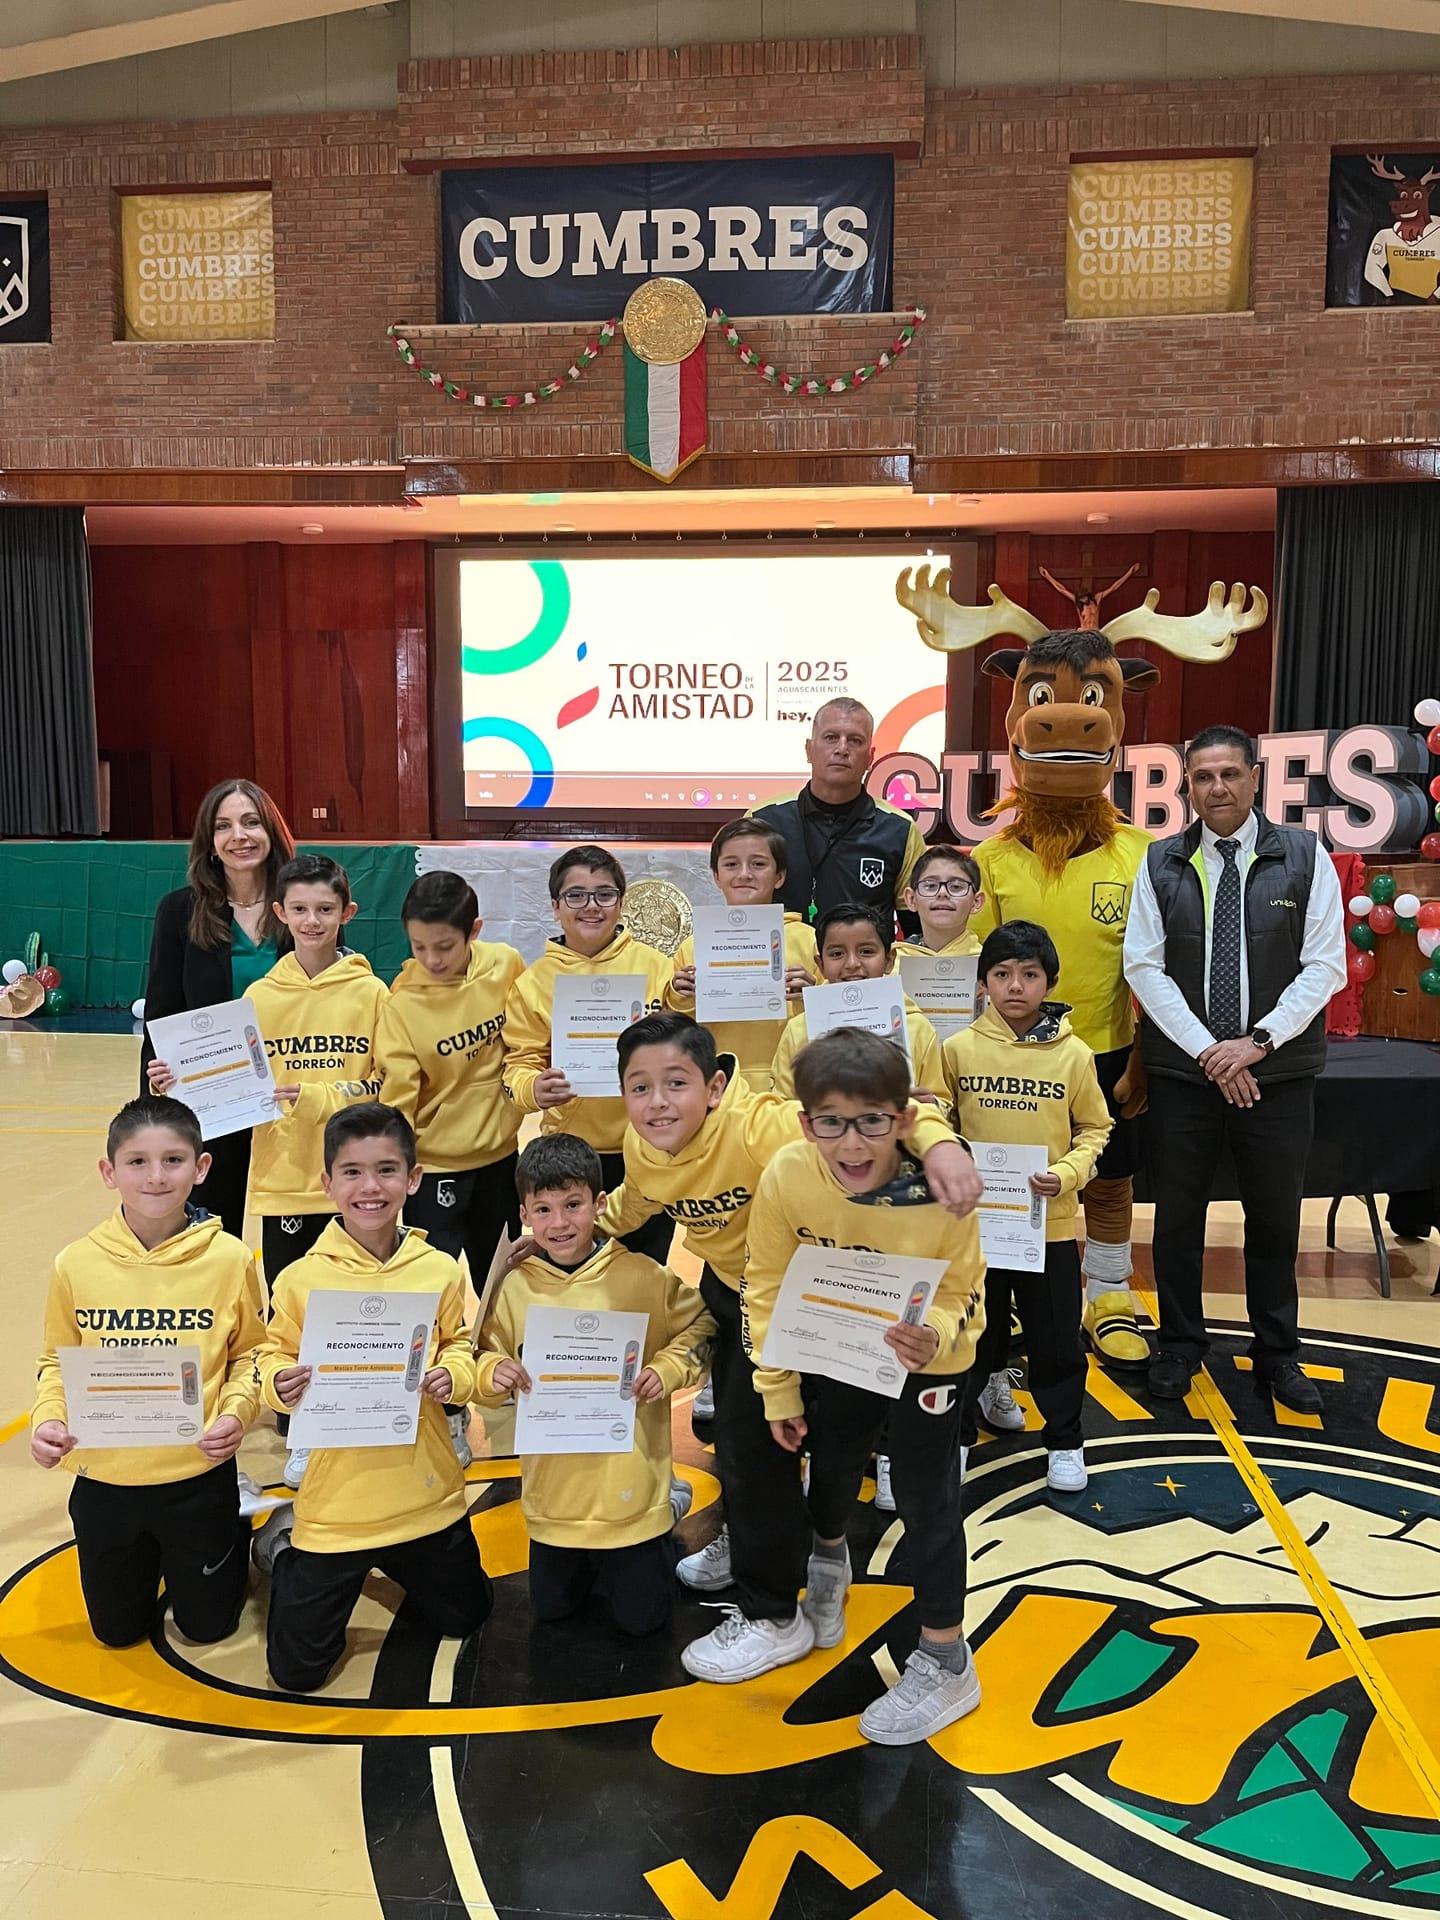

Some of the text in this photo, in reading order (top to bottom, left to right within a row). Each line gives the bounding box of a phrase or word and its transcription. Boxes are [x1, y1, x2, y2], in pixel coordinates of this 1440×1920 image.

[1079, 171, 1233, 199] CUMBRES
[1079, 197, 1232, 225] CUMBRES
[138, 229, 274, 256] CUMBRES
[459, 205, 869, 281] CUMBRES
[1078, 222, 1232, 250] CUMBRES
[138, 253, 275, 279] CUMBRES
[1078, 247, 1232, 276] CUMBRES
[139, 275, 275, 302] CUMBRES
[1077, 272, 1231, 300] CUMBRES
[139, 299, 275, 326] CUMBRES
[608, 663, 743, 689] TORNEO
[777, 661, 848, 681] 2025
[608, 694, 754, 720] AMISTAD
[866, 725, 1400, 853] CUBES
[180, 1044, 243, 1065] RECONOCIMIENTO
[264, 1035, 370, 1058] CUMBRES
[285, 1055, 346, 1070] TORREÓN
[958, 1076, 1066, 1100] CUMBRES
[978, 1097, 1038, 1112] TORREÓN
[664, 1186, 752, 1218] MBRES
[984, 1185, 1027, 1194] NOCIMIENTO
[813, 1277, 901, 1300] RECONOCIMIENTO
[76, 1308, 214, 1331] CUMBRES
[326, 1342, 405, 1350] RECONOCIMIENTO
[545, 1353, 618, 1363] RECONOCIMIENTO
